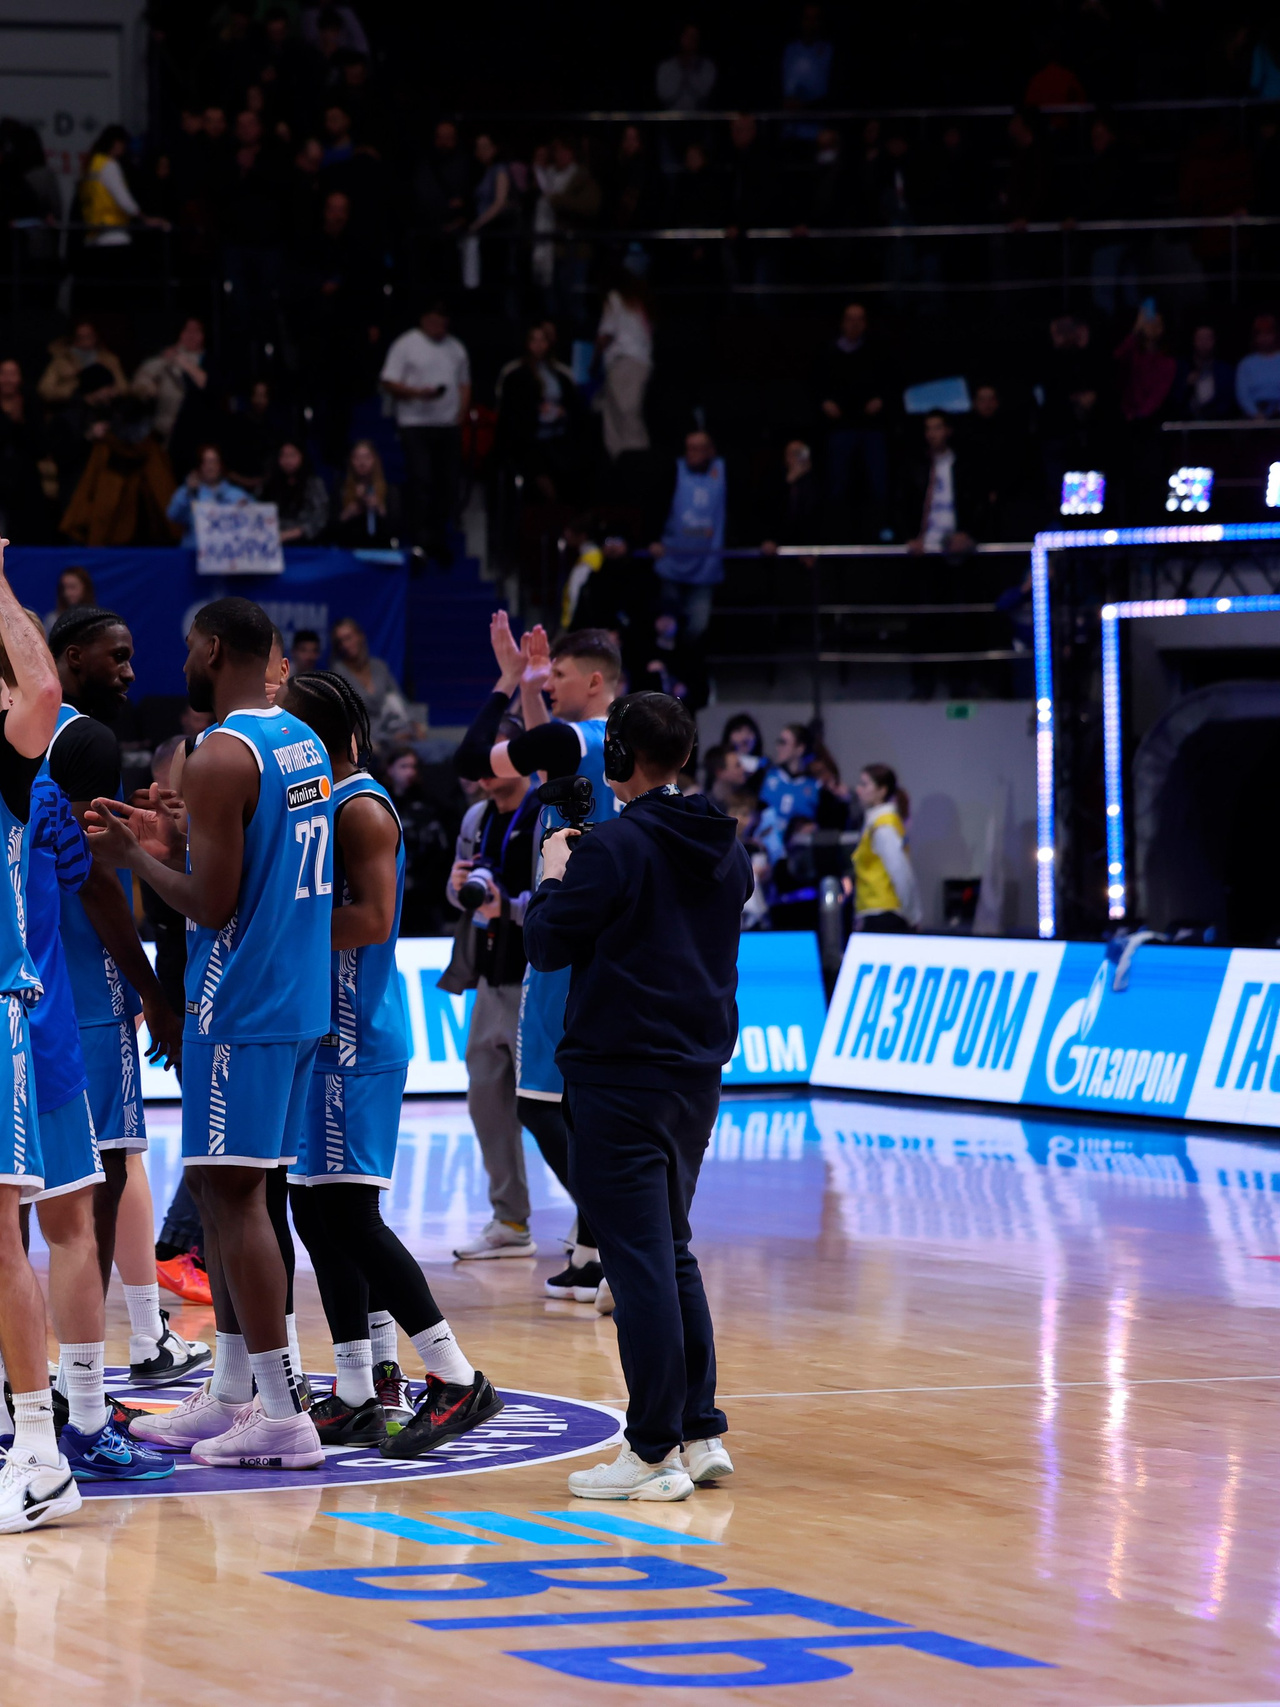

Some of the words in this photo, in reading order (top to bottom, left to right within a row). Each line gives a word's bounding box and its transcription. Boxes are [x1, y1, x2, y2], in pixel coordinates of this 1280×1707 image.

[288, 784, 318, 806] Winline
[294, 814, 332, 901] 22
[834, 963, 1039, 1071] ГАЗПРОМ
[1078, 1045, 1188, 1105] ГАЗПРОМ
